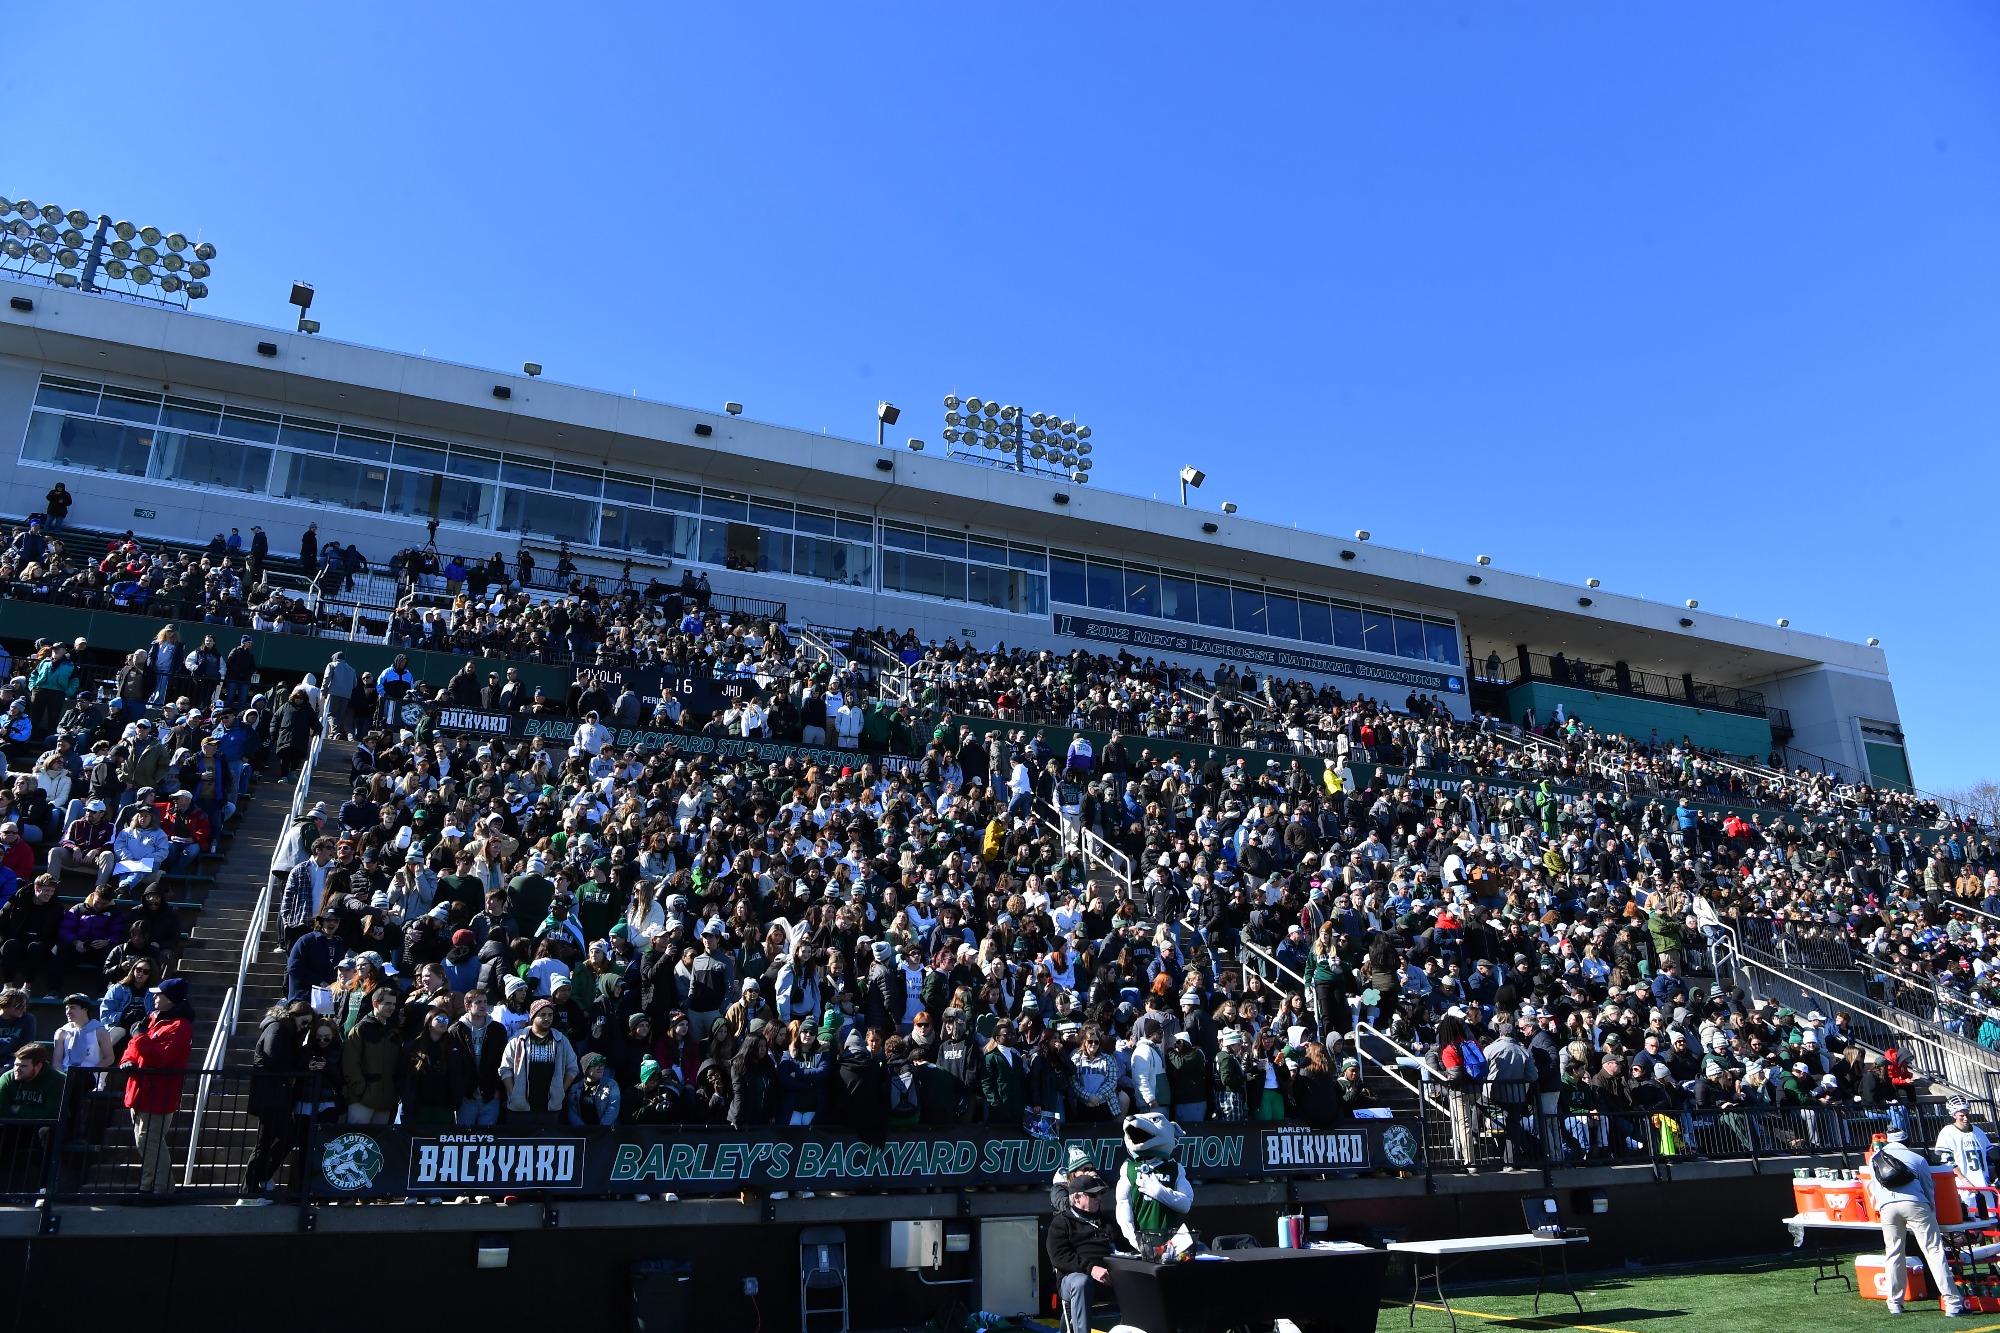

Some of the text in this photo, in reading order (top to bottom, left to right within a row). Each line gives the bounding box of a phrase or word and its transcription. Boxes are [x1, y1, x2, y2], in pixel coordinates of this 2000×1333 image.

[141, 510, 154, 518] 205
[1086, 623, 1441, 688] 2012 MEN'S LACROSSE NATIONAL CHAMPIONS
[721, 684, 743, 698] JHU
[440, 711, 508, 732] BACKYARD
[524, 718, 869, 770] BARLS BACKYARD STUDENT SECTION
[343, 1135, 374, 1150] LOYOLA
[439, 1134, 494, 1143] BARLEY'S
[1266, 1134, 1363, 1165] BACKYARD
[417, 1145, 575, 1182] BACKYARD
[610, 1142, 793, 1181] BARLEY'S
[795, 1141, 978, 1178] BACKYARD
[980, 1137, 1123, 1174] STUDENT
[325, 1166, 366, 1188] SUPERFANS
